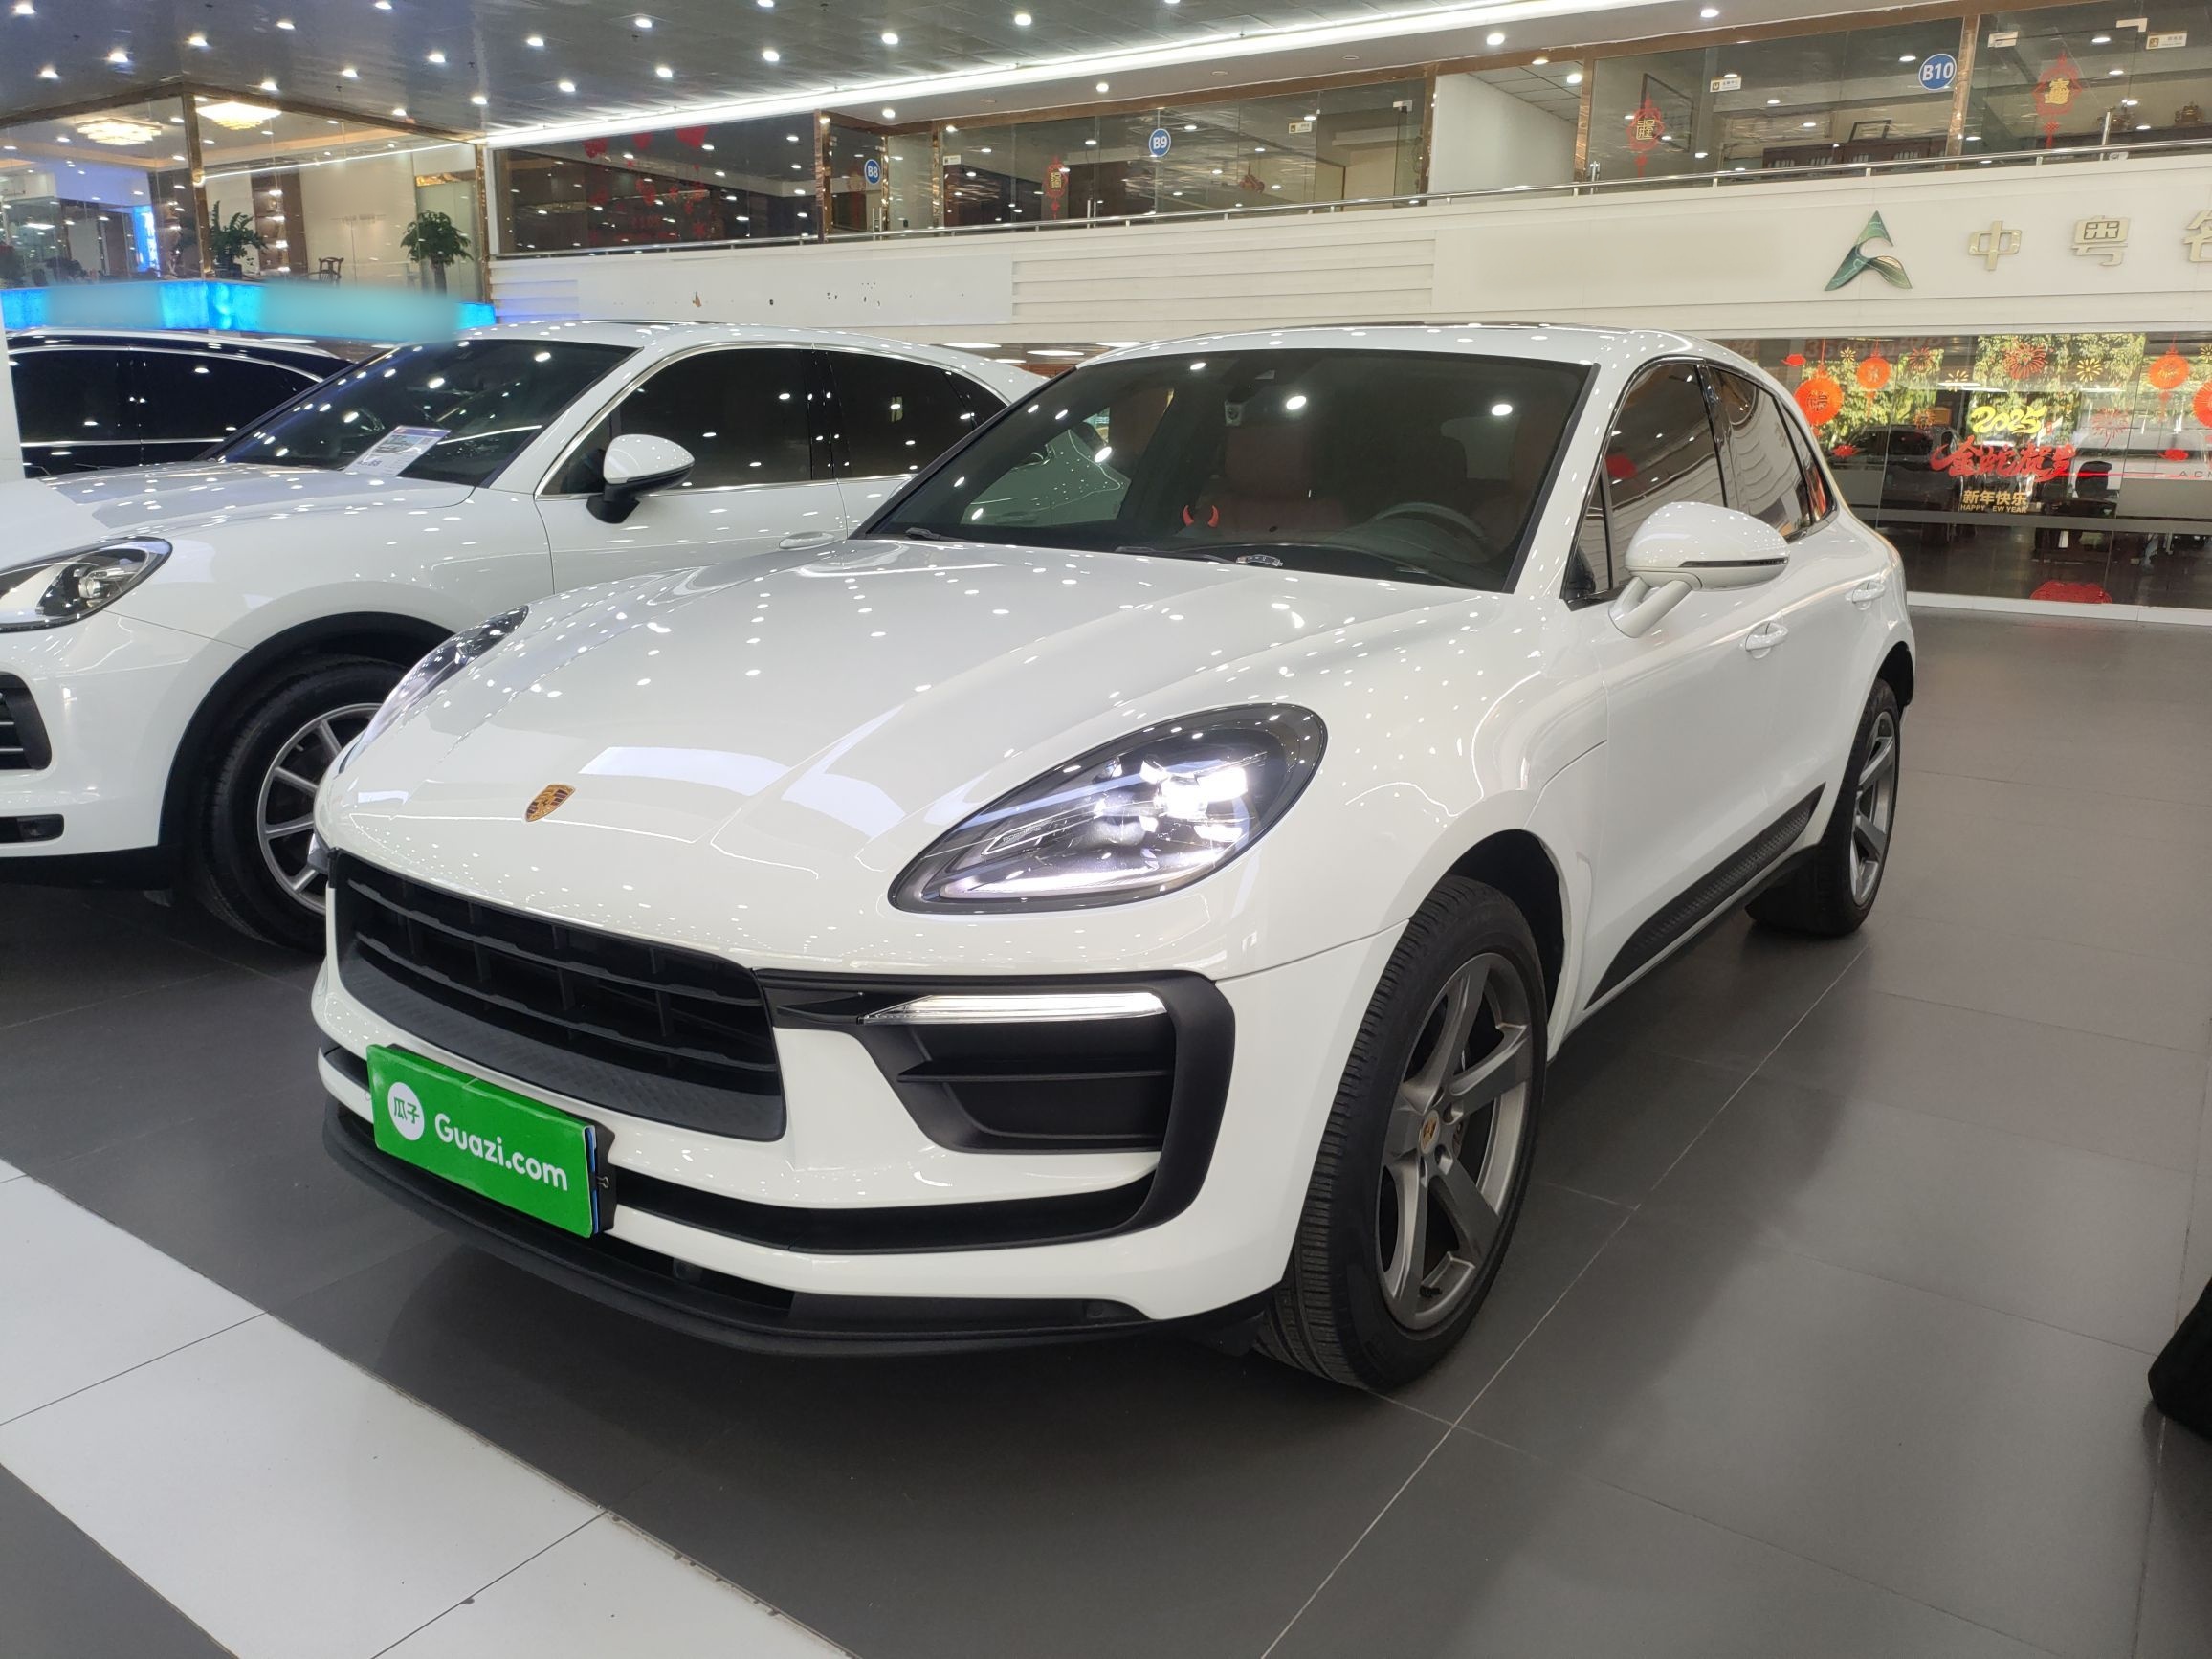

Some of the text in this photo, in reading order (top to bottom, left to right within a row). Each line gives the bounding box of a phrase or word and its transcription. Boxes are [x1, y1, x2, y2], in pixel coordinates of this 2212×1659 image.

[1923, 62, 1954, 80] B10
[1153, 136, 1167, 149] B9
[867, 166, 878, 178] B8
[1971, 406, 2047, 434] 2025
[1962, 489, 2027, 506] 新年快乐
[2005, 505, 2028, 514] YEAR
[393, 1097, 421, 1125] 瓜子
[434, 1112, 568, 1192] Guazi.com
